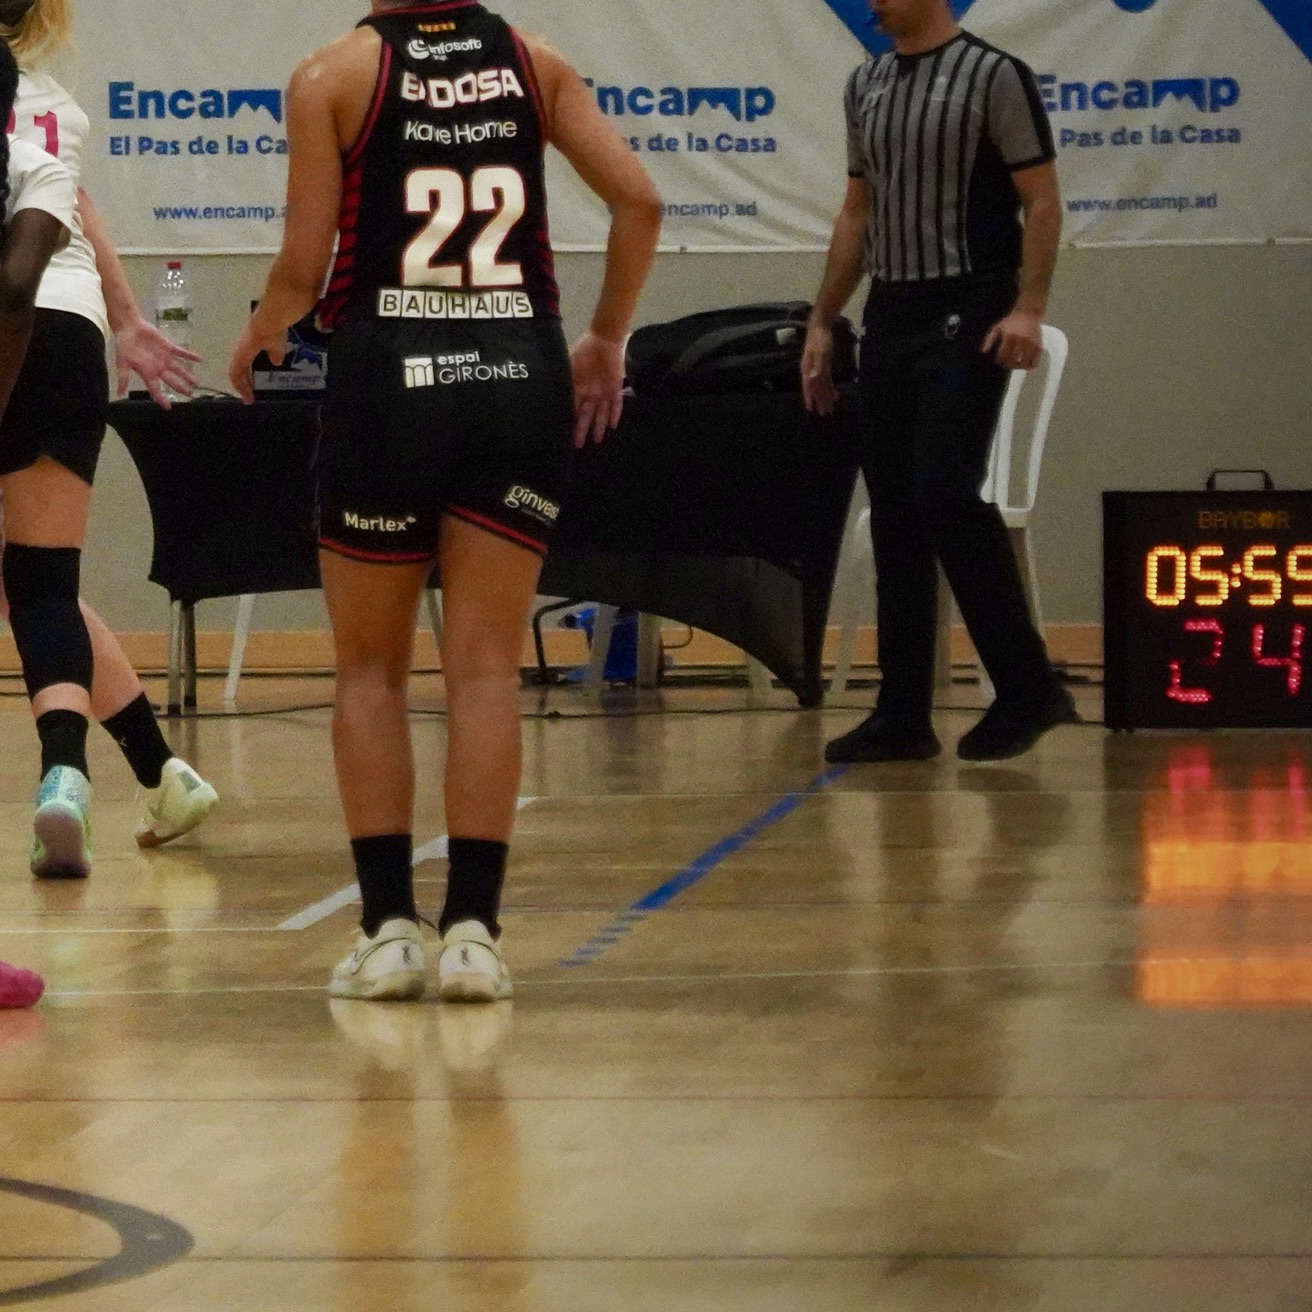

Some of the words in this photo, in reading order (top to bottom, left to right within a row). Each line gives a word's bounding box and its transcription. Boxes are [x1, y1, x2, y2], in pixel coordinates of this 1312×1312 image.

[583, 78, 775, 122] ncamp
[455, 121, 518, 145] Home
[647, 133, 679, 152] de
[687, 131, 709, 152] la
[715, 133, 777, 152] Casa
[1060, 128, 1104, 147] Pas
[1110, 126, 1143, 146] de
[1151, 124, 1173, 145] la
[1179, 124, 1242, 144] Casa
[109, 136, 130, 155] El
[138, 137, 180, 156] Pas
[188, 136, 219, 155] de
[228, 135, 250, 155] la
[1066, 193, 1219, 214] www.encamp.ad
[403, 166, 526, 287] 22
[380, 291, 533, 317] BAUHAUS
[437, 351, 480, 366] espai
[439, 361, 529, 385] GIRONÈS
[344, 511, 407, 532] Marlex
[1166, 618, 1306, 704] 24
